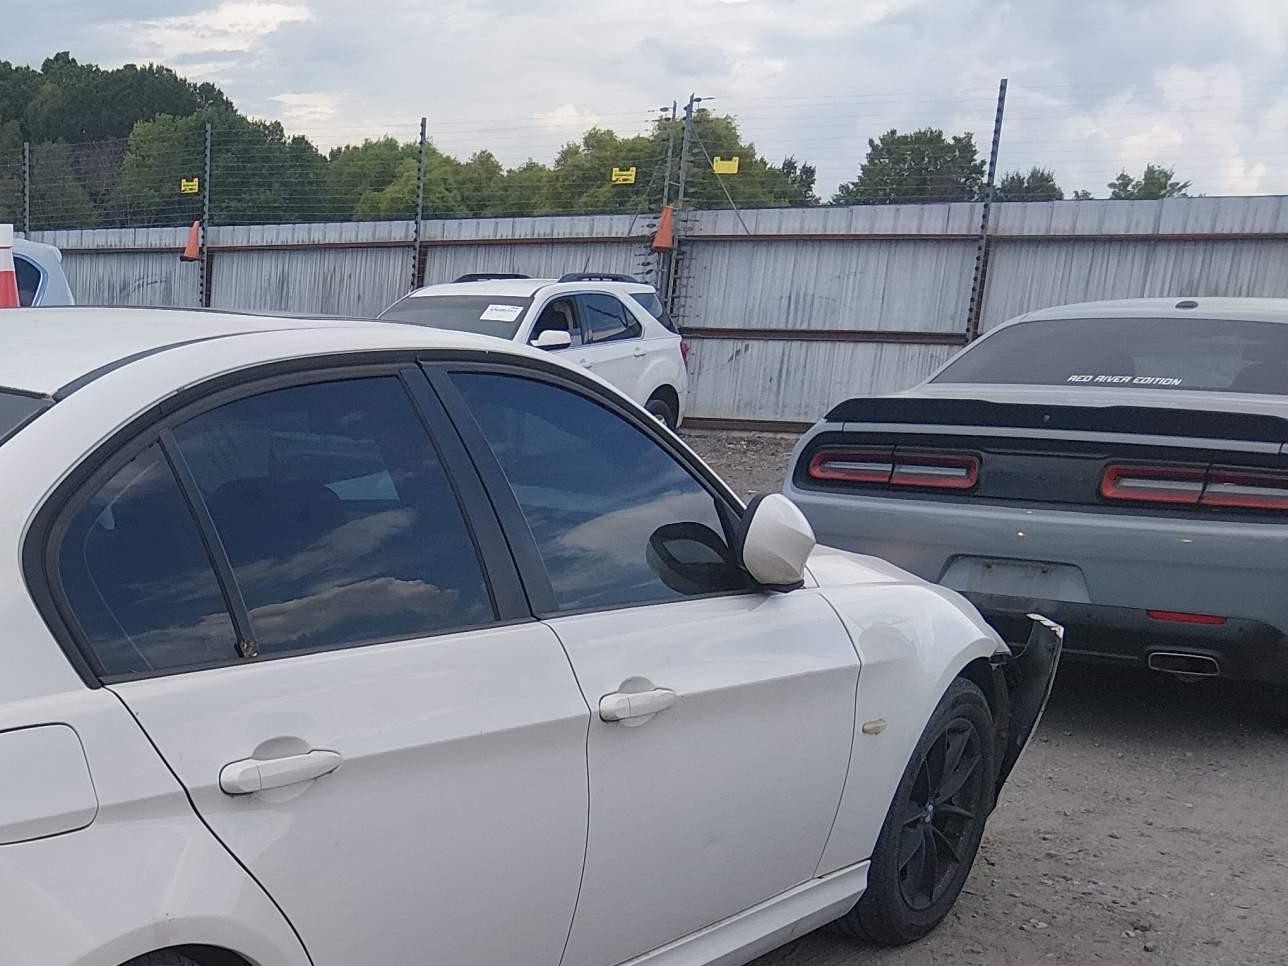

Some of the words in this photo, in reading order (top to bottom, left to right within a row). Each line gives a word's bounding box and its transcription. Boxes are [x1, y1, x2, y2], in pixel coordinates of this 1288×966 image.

[1067, 375, 1092, 383] RED
[1093, 375, 1130, 384] RIVER
[1133, 376, 1182, 386] EDITION
